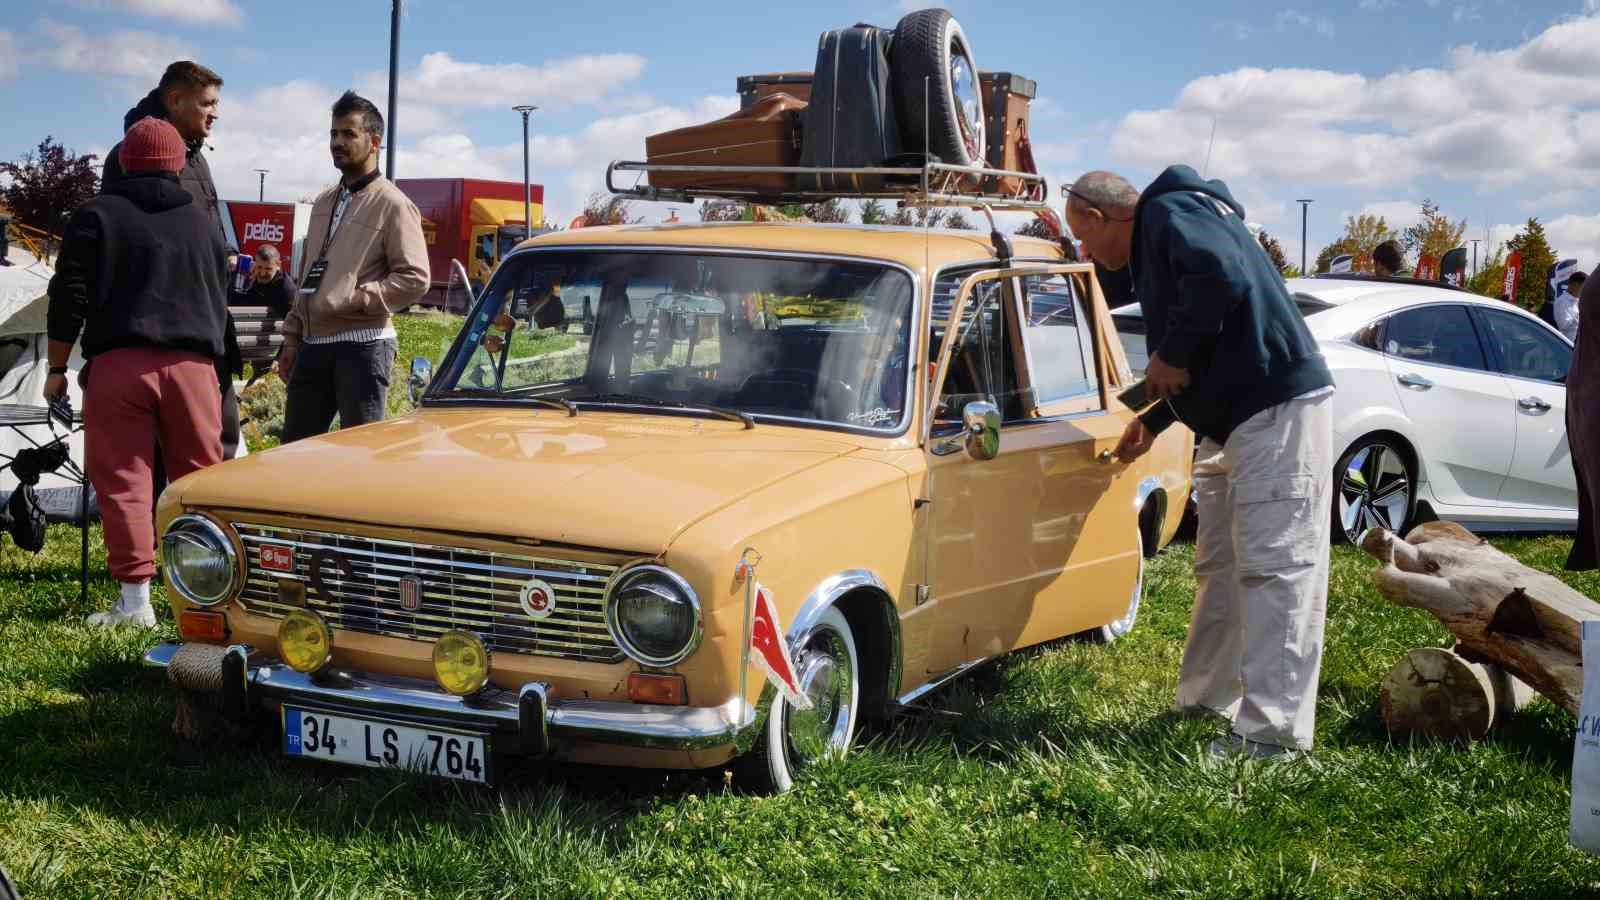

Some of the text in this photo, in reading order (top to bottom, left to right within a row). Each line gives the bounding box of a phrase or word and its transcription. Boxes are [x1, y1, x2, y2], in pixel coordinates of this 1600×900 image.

[287, 716, 482, 778] TR 34 LS 764
